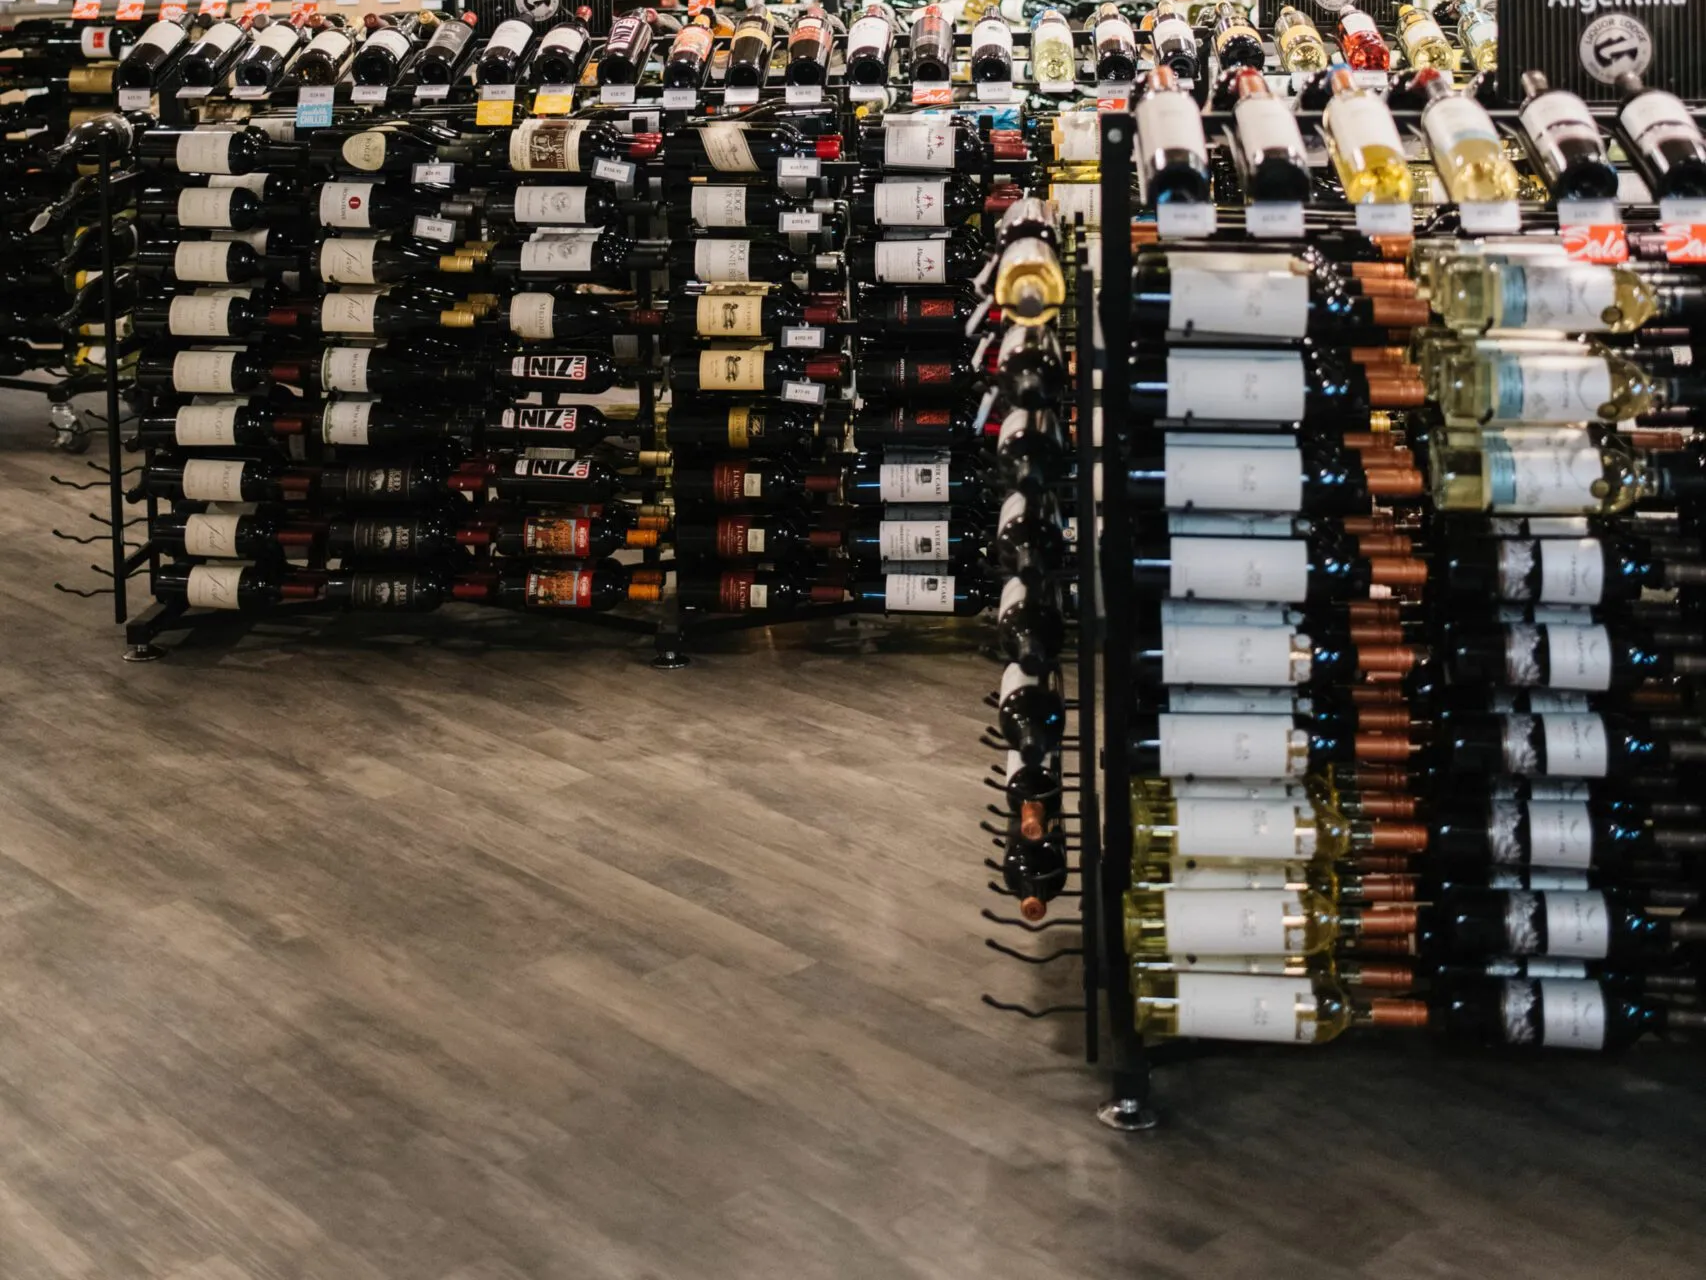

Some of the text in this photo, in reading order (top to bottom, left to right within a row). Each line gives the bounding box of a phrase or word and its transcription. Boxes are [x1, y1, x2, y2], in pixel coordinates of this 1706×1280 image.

[1585, 19, 1616, 45] LIQUOR
[912, 90, 949, 104] Sale
[1563, 228, 1628, 260] Sale
